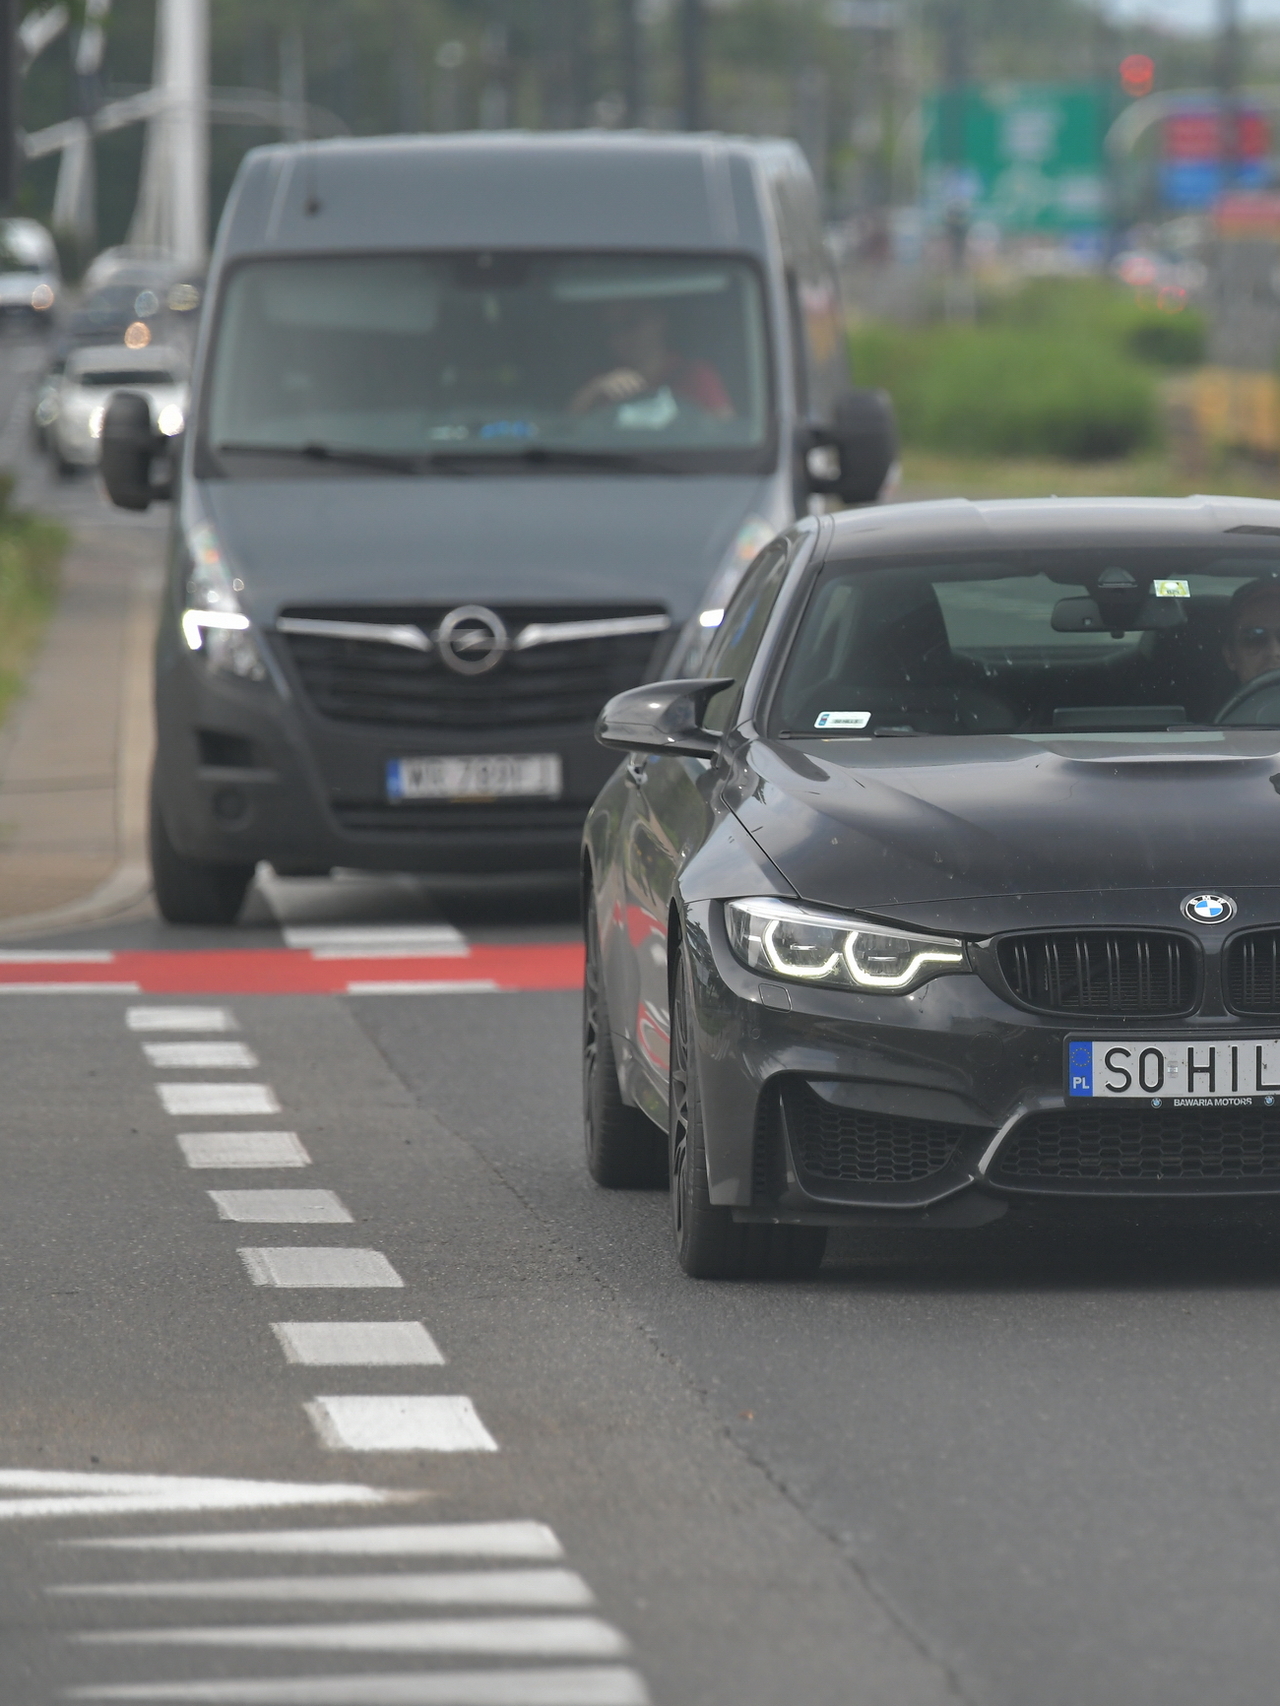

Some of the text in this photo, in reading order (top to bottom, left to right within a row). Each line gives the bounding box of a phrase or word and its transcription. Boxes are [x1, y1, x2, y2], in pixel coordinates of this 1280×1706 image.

[1072, 1076, 1090, 1090] PL
[1173, 1096, 1253, 1107] BAWARIA MOTORS
